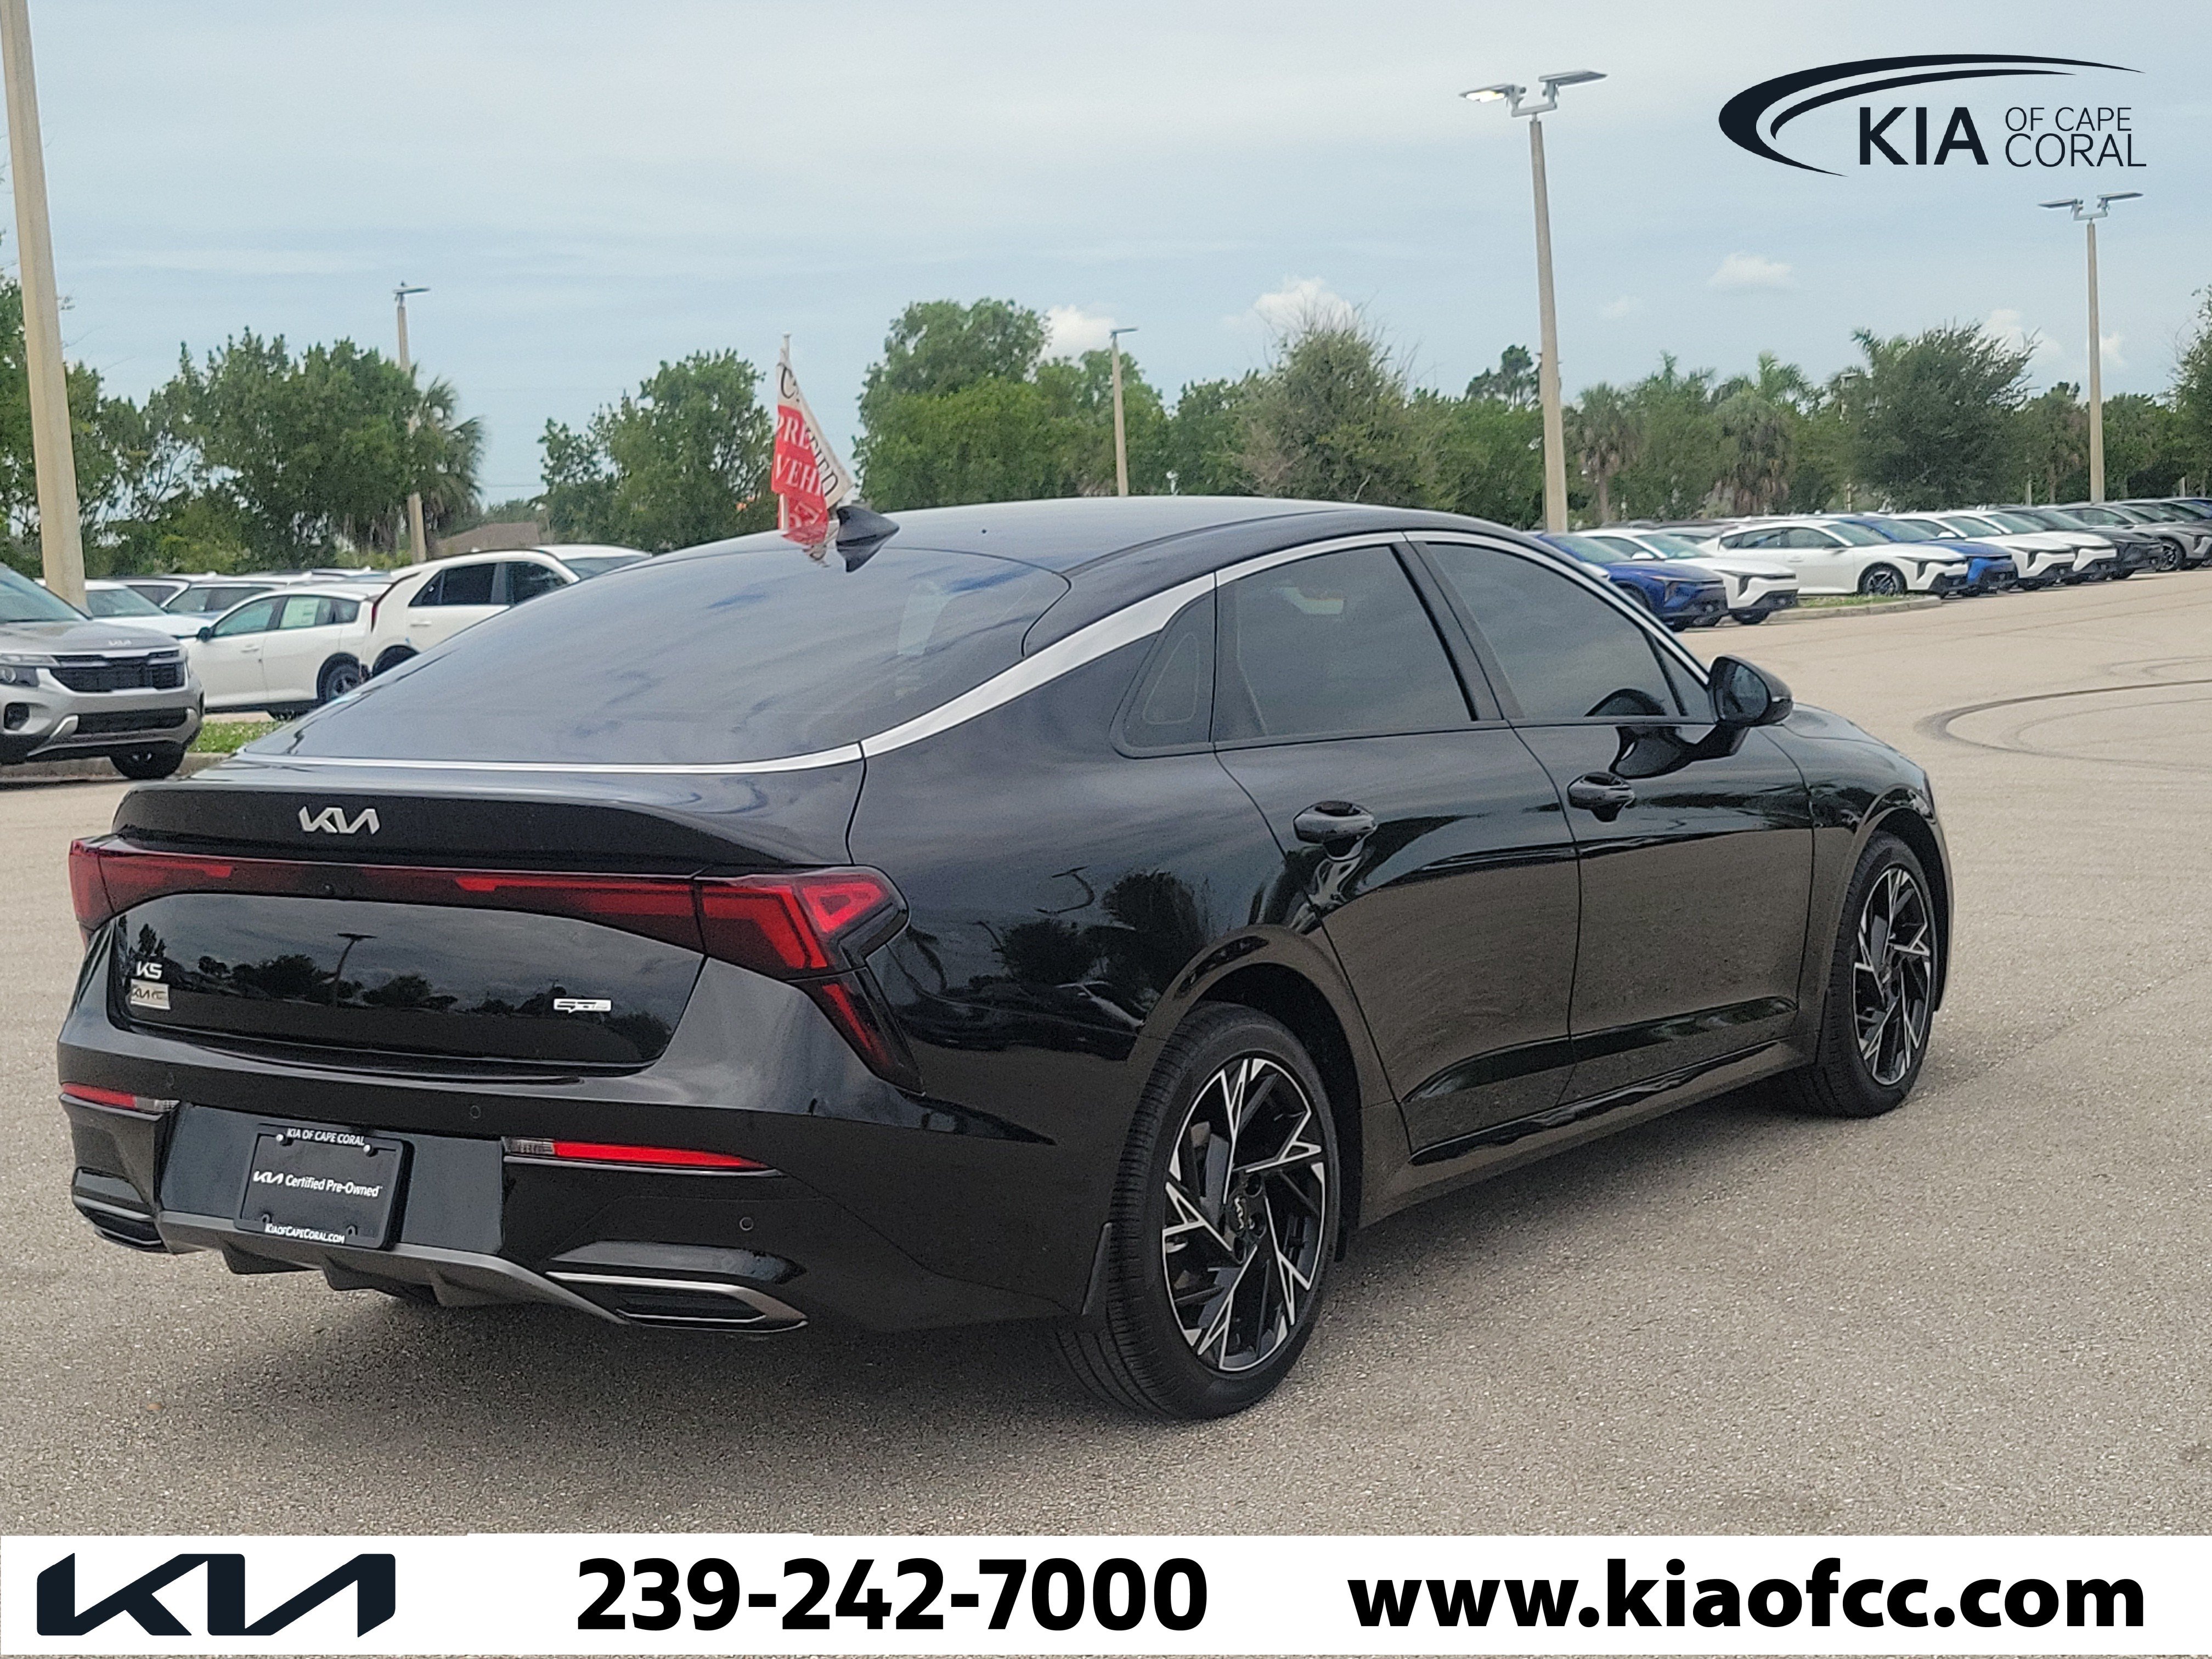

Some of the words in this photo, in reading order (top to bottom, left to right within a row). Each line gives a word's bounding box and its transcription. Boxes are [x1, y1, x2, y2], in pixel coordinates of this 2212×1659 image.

[298, 805, 380, 834] KIA
[137, 961, 162, 979] K5
[286, 1128, 301, 1138] KIA
[302, 1130, 314, 1140] OF
[314, 1131, 337, 1143] CAPE
[337, 1133, 365, 1146] CORAL
[252, 1171, 284, 1184] KIA
[285, 1174, 325, 1190] Certified
[326, 1180, 379, 1197] Pre-Owned
